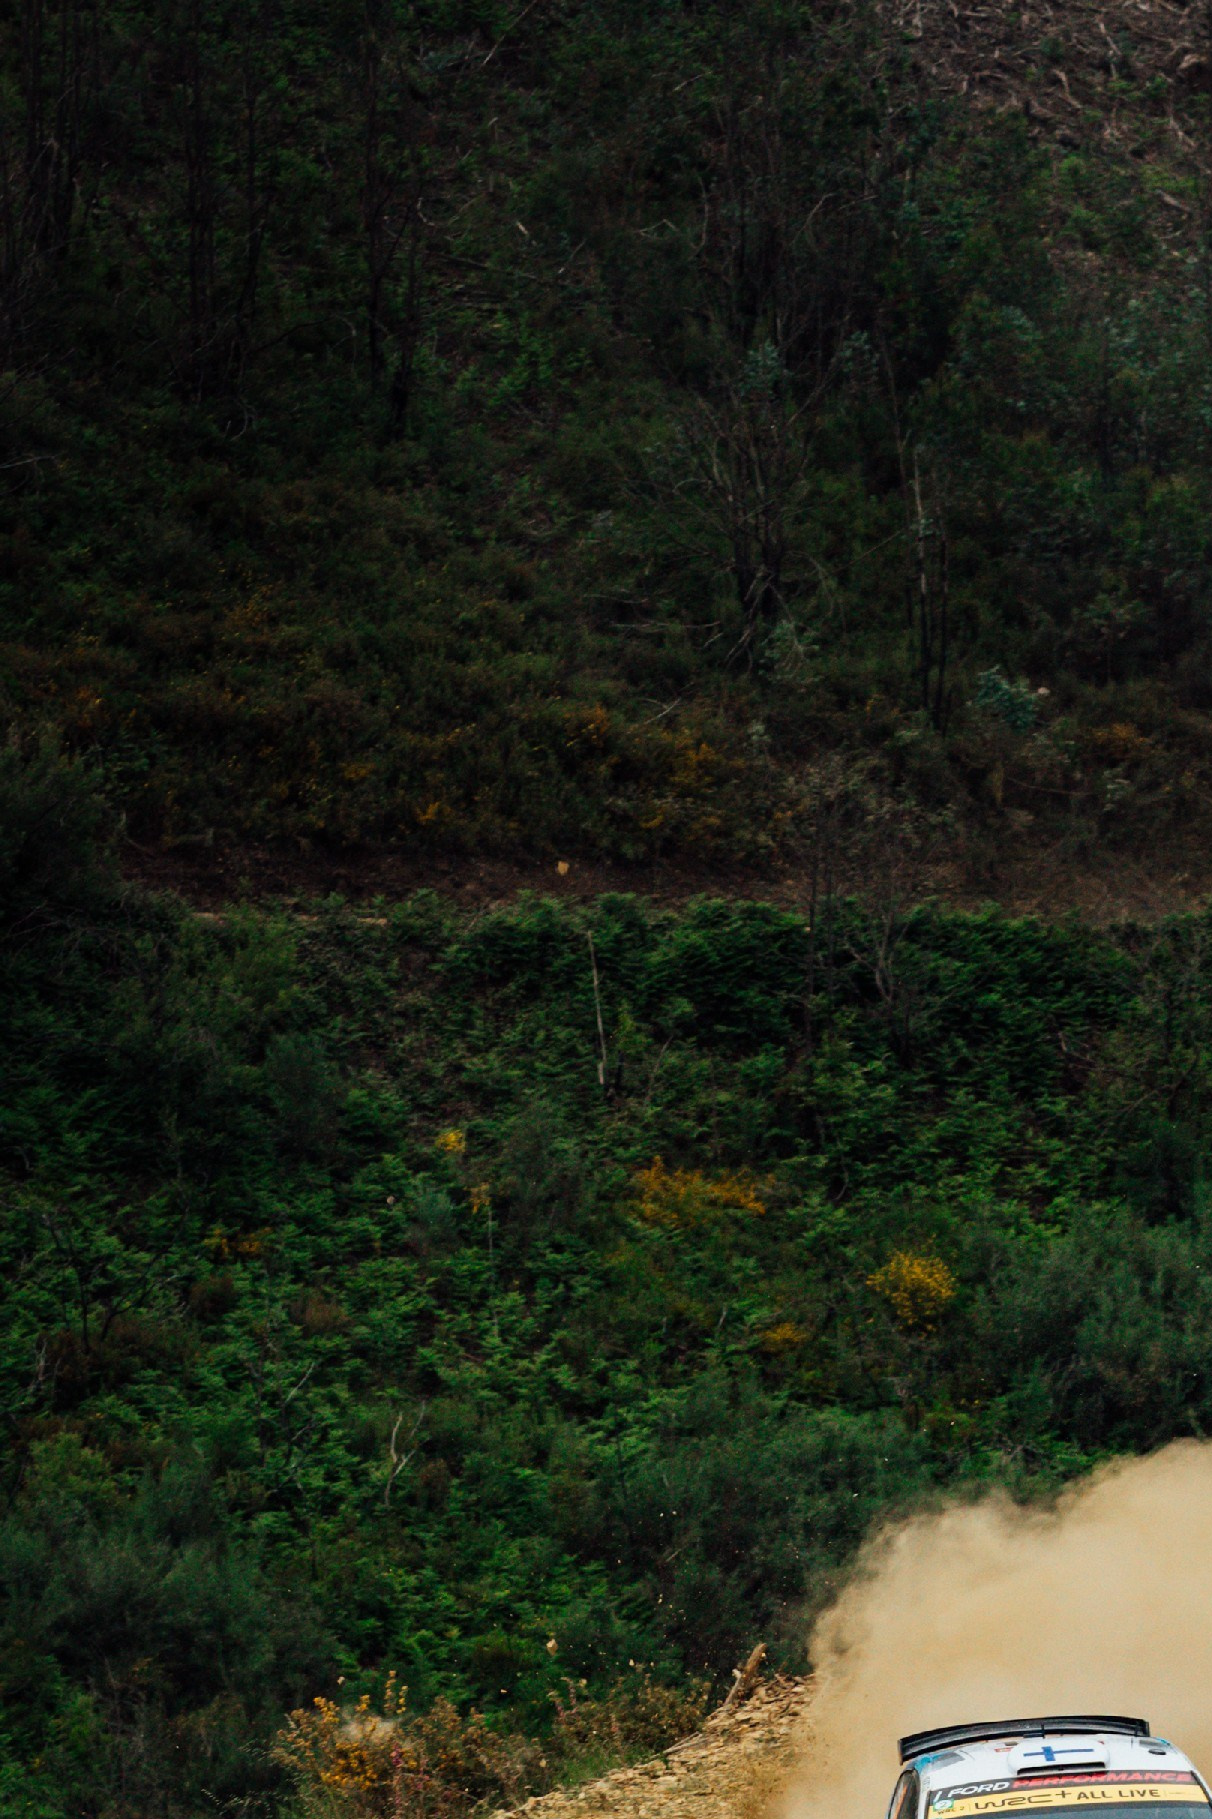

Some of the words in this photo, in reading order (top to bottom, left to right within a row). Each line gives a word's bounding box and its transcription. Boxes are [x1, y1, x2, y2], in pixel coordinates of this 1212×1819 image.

[948, 1782, 1010, 1798] FORD
[1012, 1772, 1193, 1789] PERFORMANCE
[1077, 1790, 1112, 1800] ALL
[1118, 1789, 1161, 1798] LIVE
